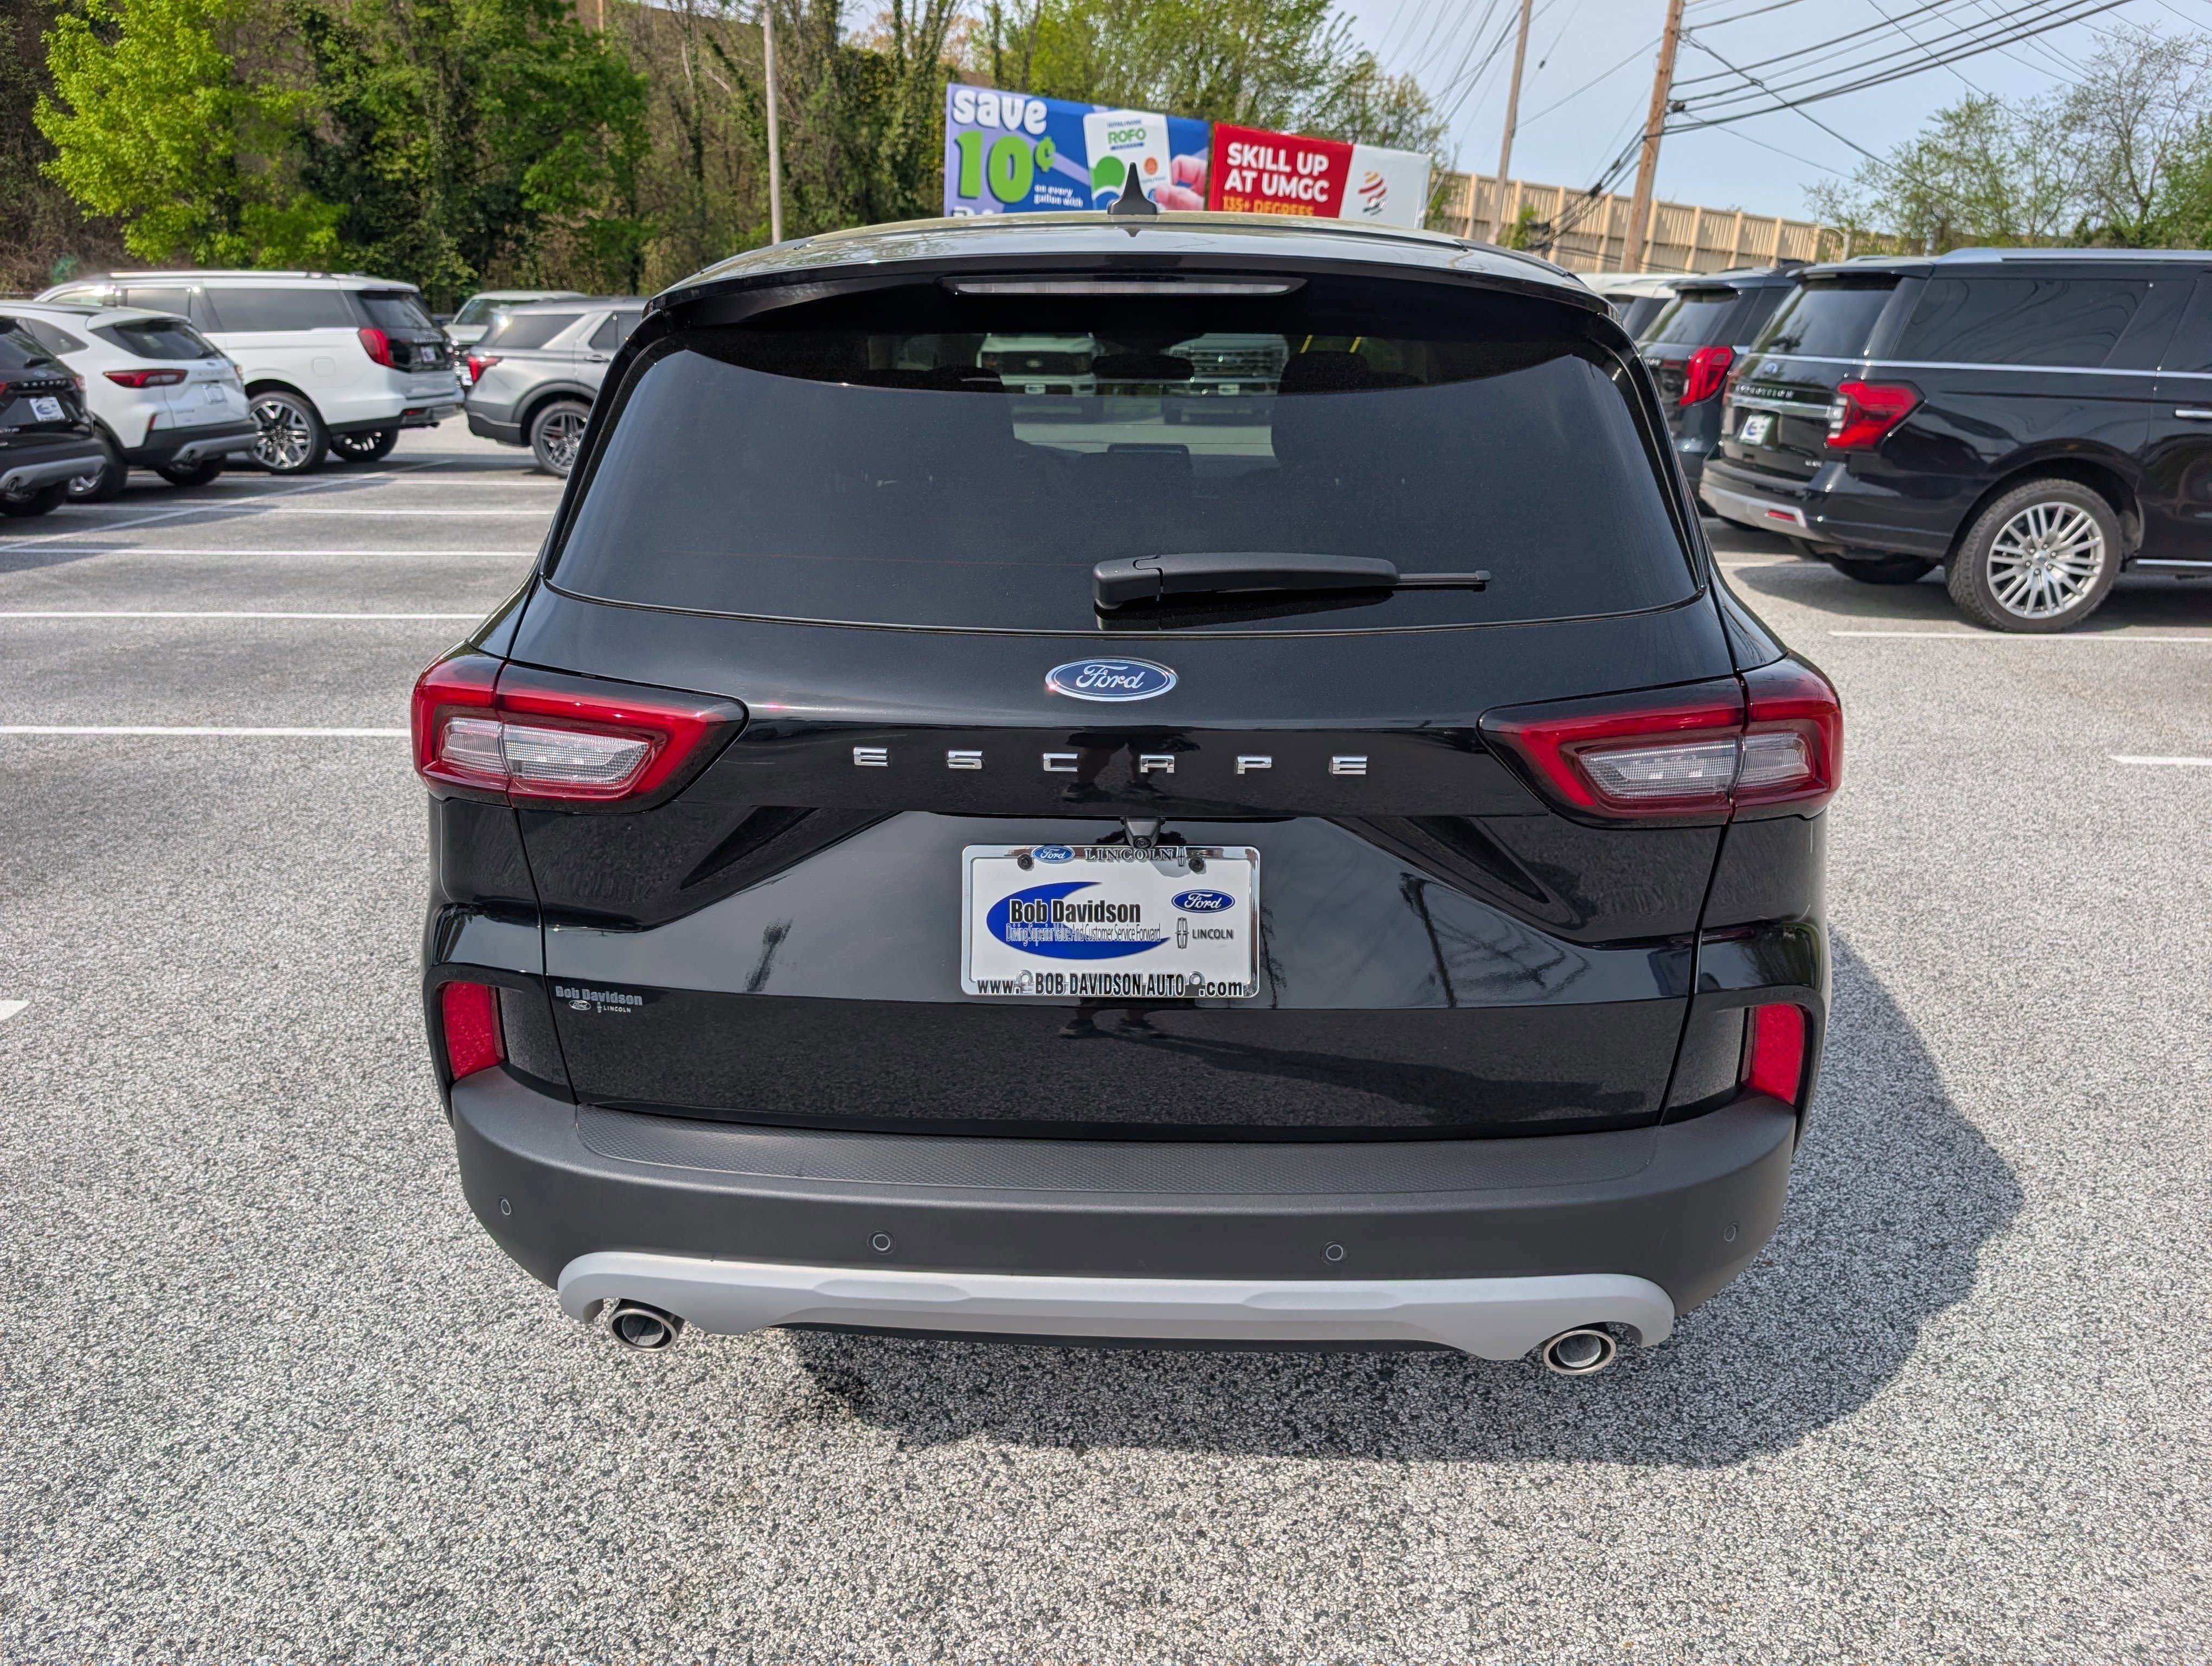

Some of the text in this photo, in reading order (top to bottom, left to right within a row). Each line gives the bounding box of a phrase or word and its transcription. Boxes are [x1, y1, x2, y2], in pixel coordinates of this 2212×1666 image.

[953, 89, 1047, 135] save
[1107, 128, 1147, 144] ROFO
[1227, 142, 1329, 176] SKILL UP
[1224, 168, 1330, 203] AT UMGC
[1076, 664, 1146, 689] Ford
[853, 747, 1368, 776] ESCAPE
[1040, 847, 1174, 862] Ford LINCOLN
[1009, 899, 1141, 923] Bob Davidson
[1184, 893, 1222, 908] Ford
[1006, 923, 1161, 946] Driving Superior Value And Customer Service Forward
[1192, 928, 1234, 939] LINCOLN
[555, 985, 642, 1005] Bob Davidson
[977, 972, 1244, 997] www. BOB DAVIDSON AUTO .com
[603, 1005, 631, 1013] LINCOLN
